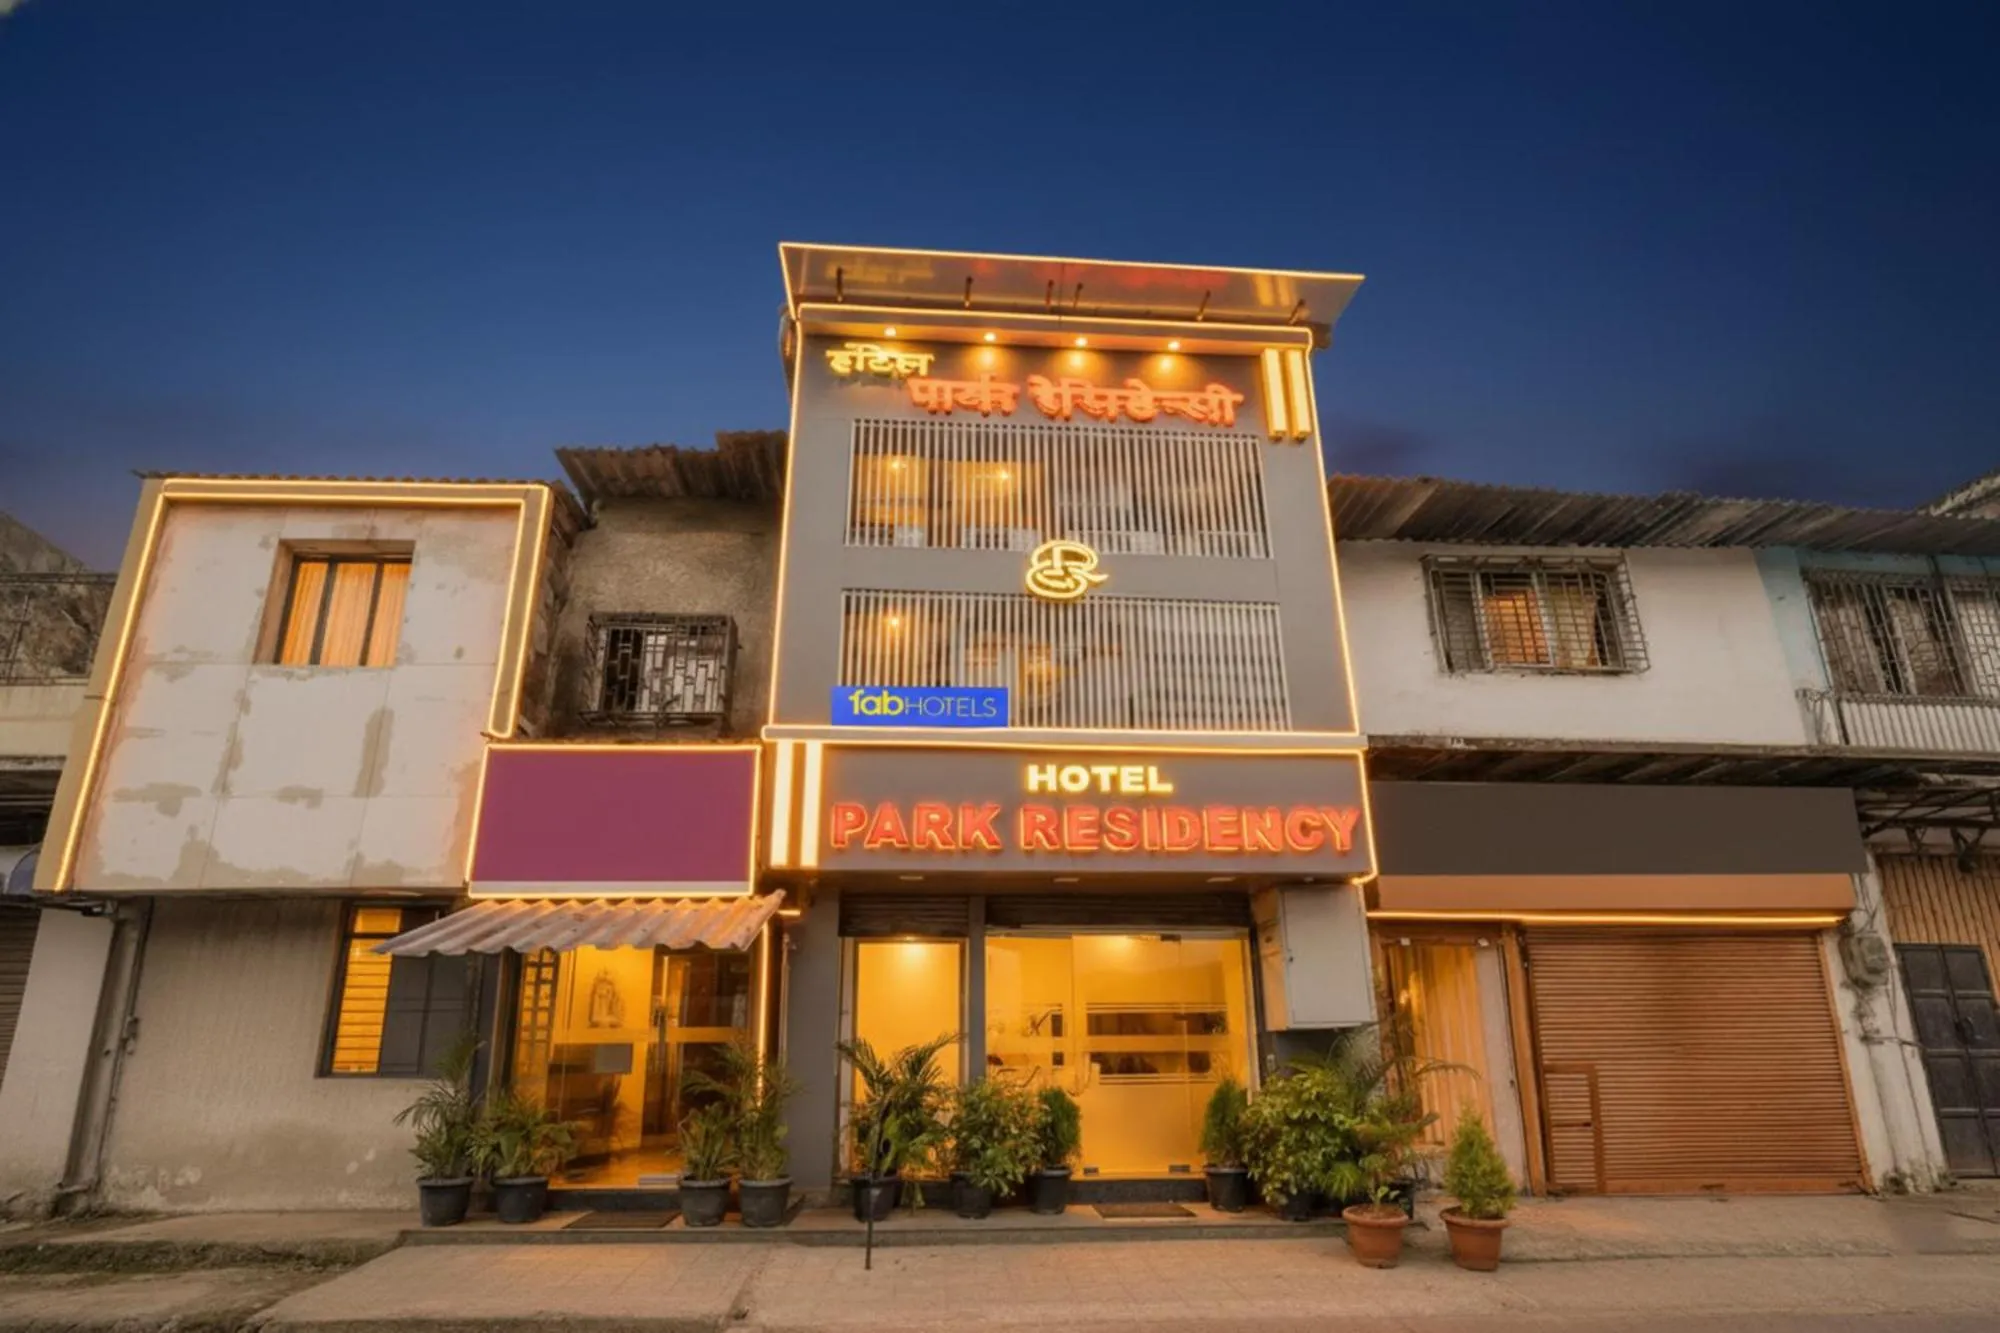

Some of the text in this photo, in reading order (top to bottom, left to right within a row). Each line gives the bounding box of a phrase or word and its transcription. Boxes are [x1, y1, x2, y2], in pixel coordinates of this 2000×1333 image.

[1026, 764, 1174, 793] HOTEL
[830, 803, 1362, 854] PARK RESIDENCY
